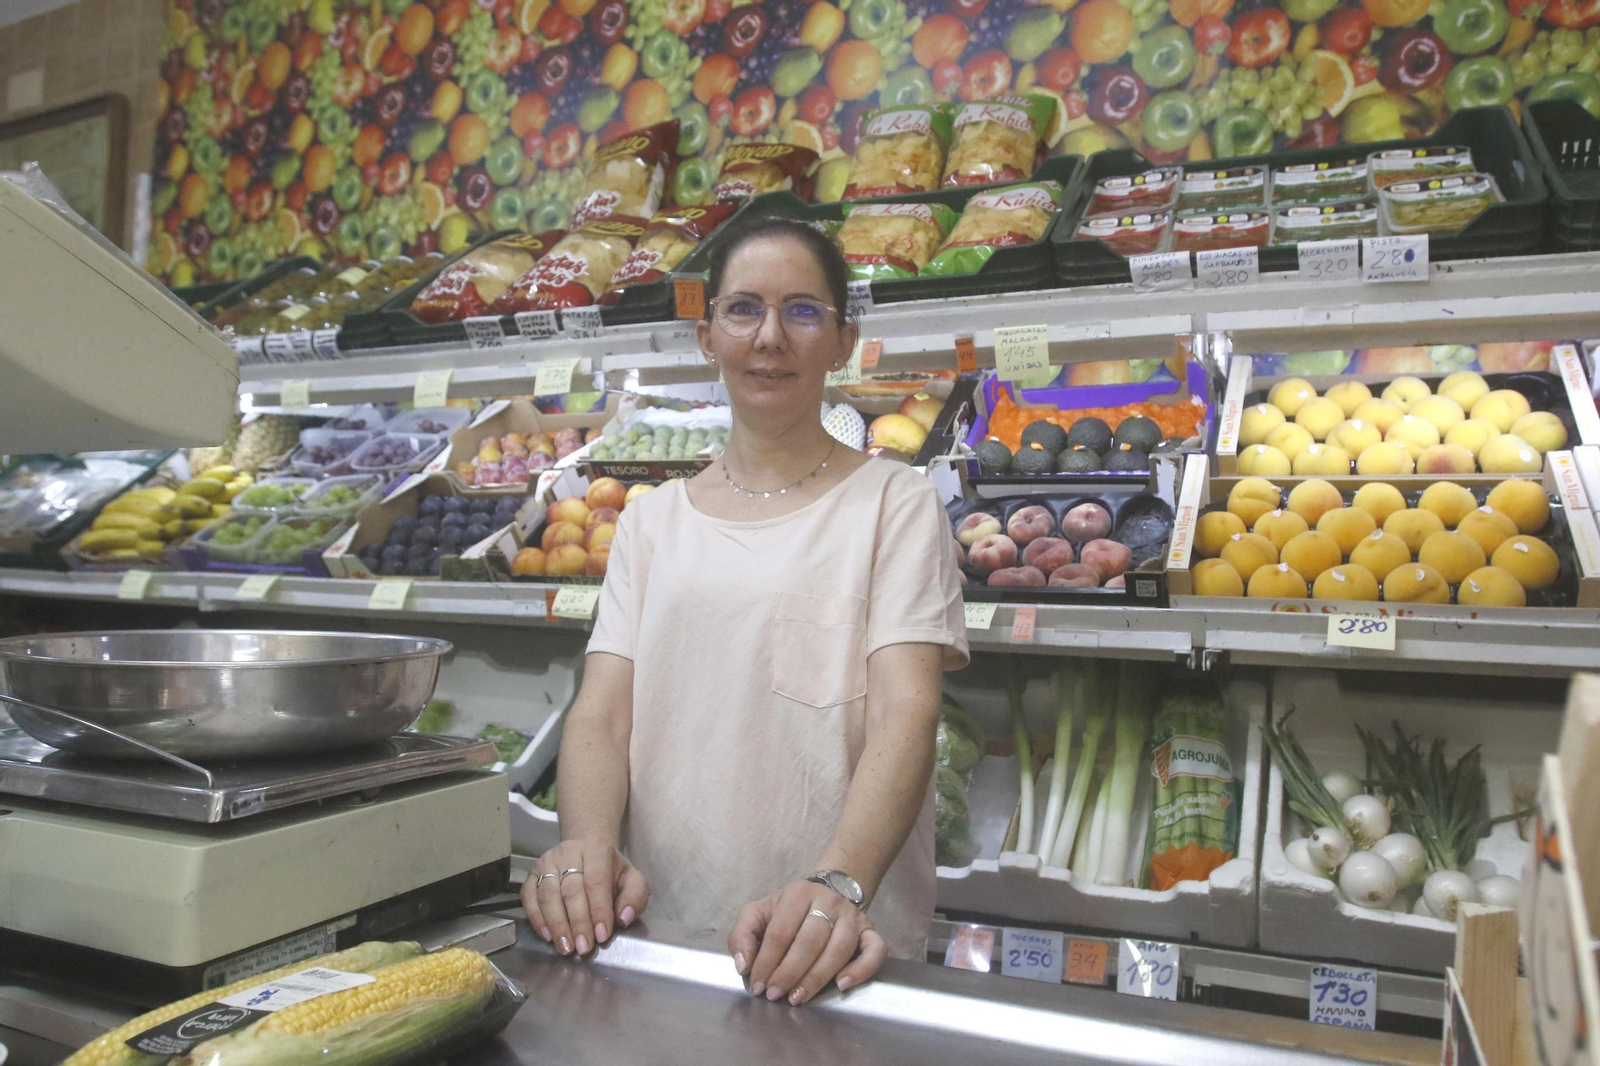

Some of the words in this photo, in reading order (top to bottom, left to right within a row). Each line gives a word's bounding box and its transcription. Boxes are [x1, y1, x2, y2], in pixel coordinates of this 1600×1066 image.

[889, 110, 933, 135] Rubia
[980, 105, 1032, 131] Rubia
[994, 188, 1055, 211] Rubia
[1206, 270, 1249, 288] 2'80
[602, 466, 649, 475] TESORO
[665, 470, 699, 479] ROJO
[1171, 748, 1232, 774] AGROJUMA
[1009, 949, 1053, 968] 2'50
[1067, 951, 1098, 970] 34
